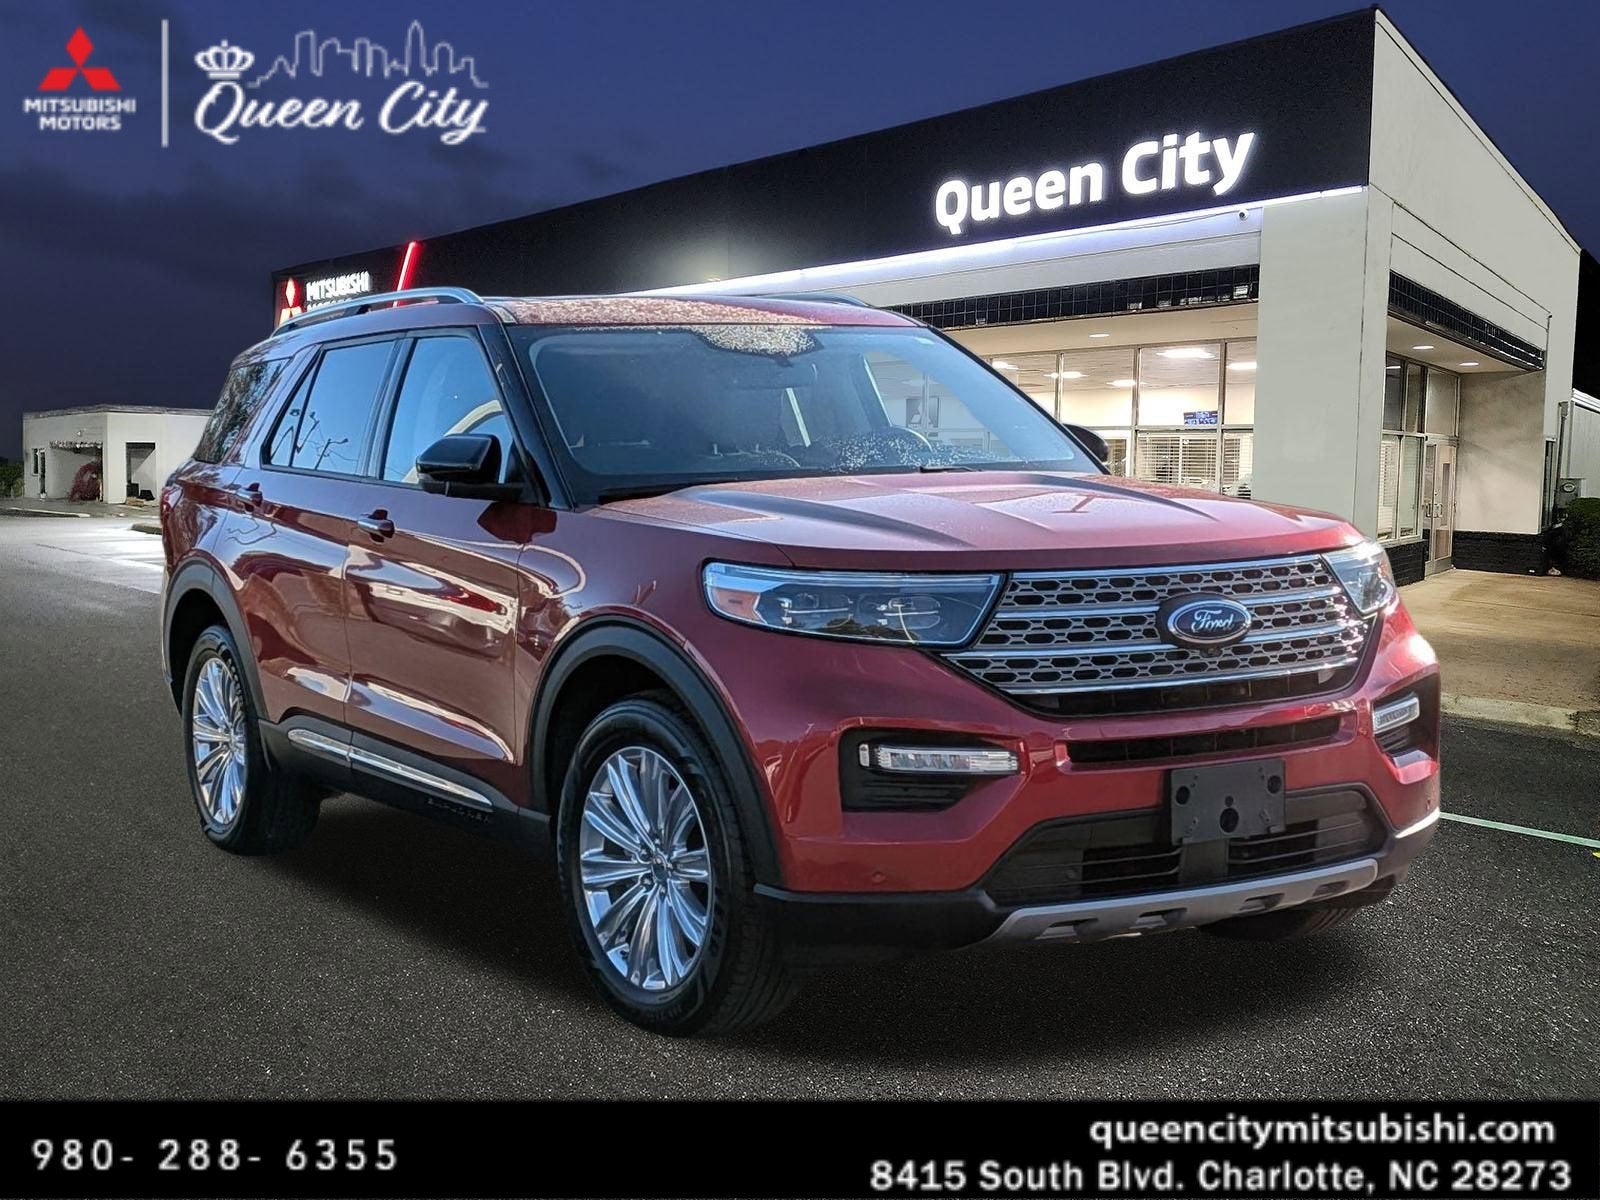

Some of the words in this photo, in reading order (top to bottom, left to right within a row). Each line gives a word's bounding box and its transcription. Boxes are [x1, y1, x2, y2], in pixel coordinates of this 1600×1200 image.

[935, 162, 1104, 235] Queen
[1121, 131, 1256, 197] City
[306, 271, 370, 301] MITSUBISHI
[1191, 609, 1234, 633] Ford
